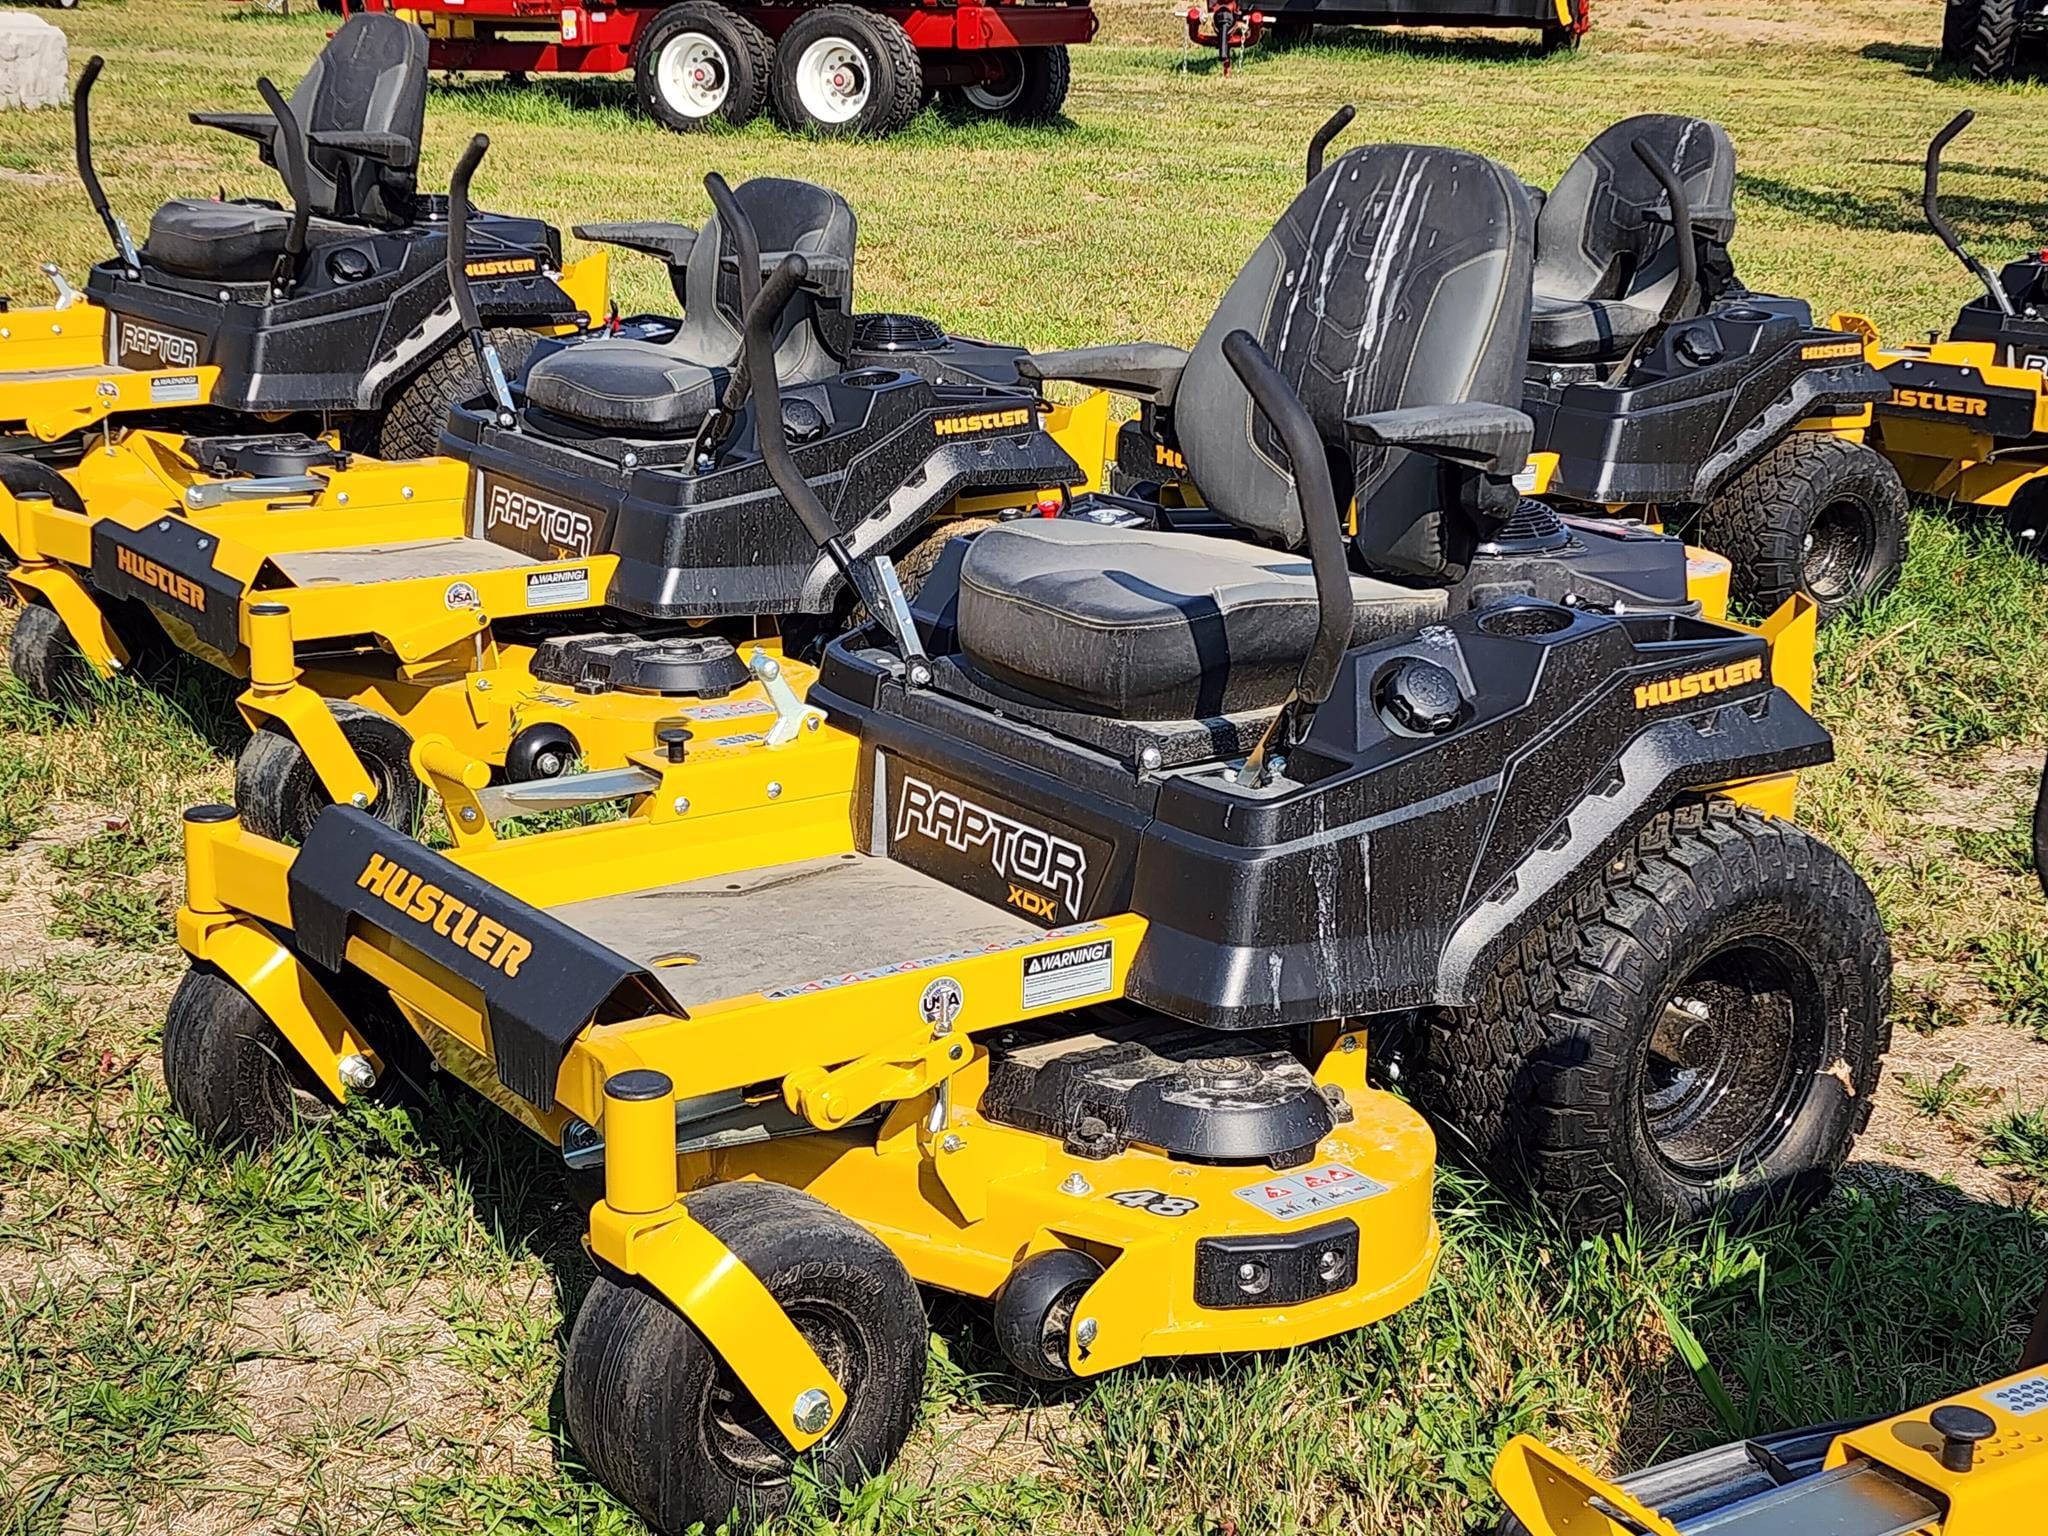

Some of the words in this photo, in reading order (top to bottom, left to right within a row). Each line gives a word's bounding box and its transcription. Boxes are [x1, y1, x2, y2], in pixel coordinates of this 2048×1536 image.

[120, 322, 198, 368] RAPTOR
[1801, 343, 1862, 360] HUSTLER
[934, 409, 1030, 435] HUSTLER
[488, 485, 593, 560] RAPTOR
[116, 544, 206, 613] HUSTLER
[538, 570, 586, 584] WARNING!
[447, 592, 473, 603] USA
[1633, 656, 1763, 709] HUSTLER
[894, 775, 1087, 921] RAPTOR
[356, 852, 533, 978] HUSTLER
[1007, 884, 1056, 921] XDX
[1041, 943, 1109, 971] WARNING!
[1106, 1189, 1200, 1217] 48
